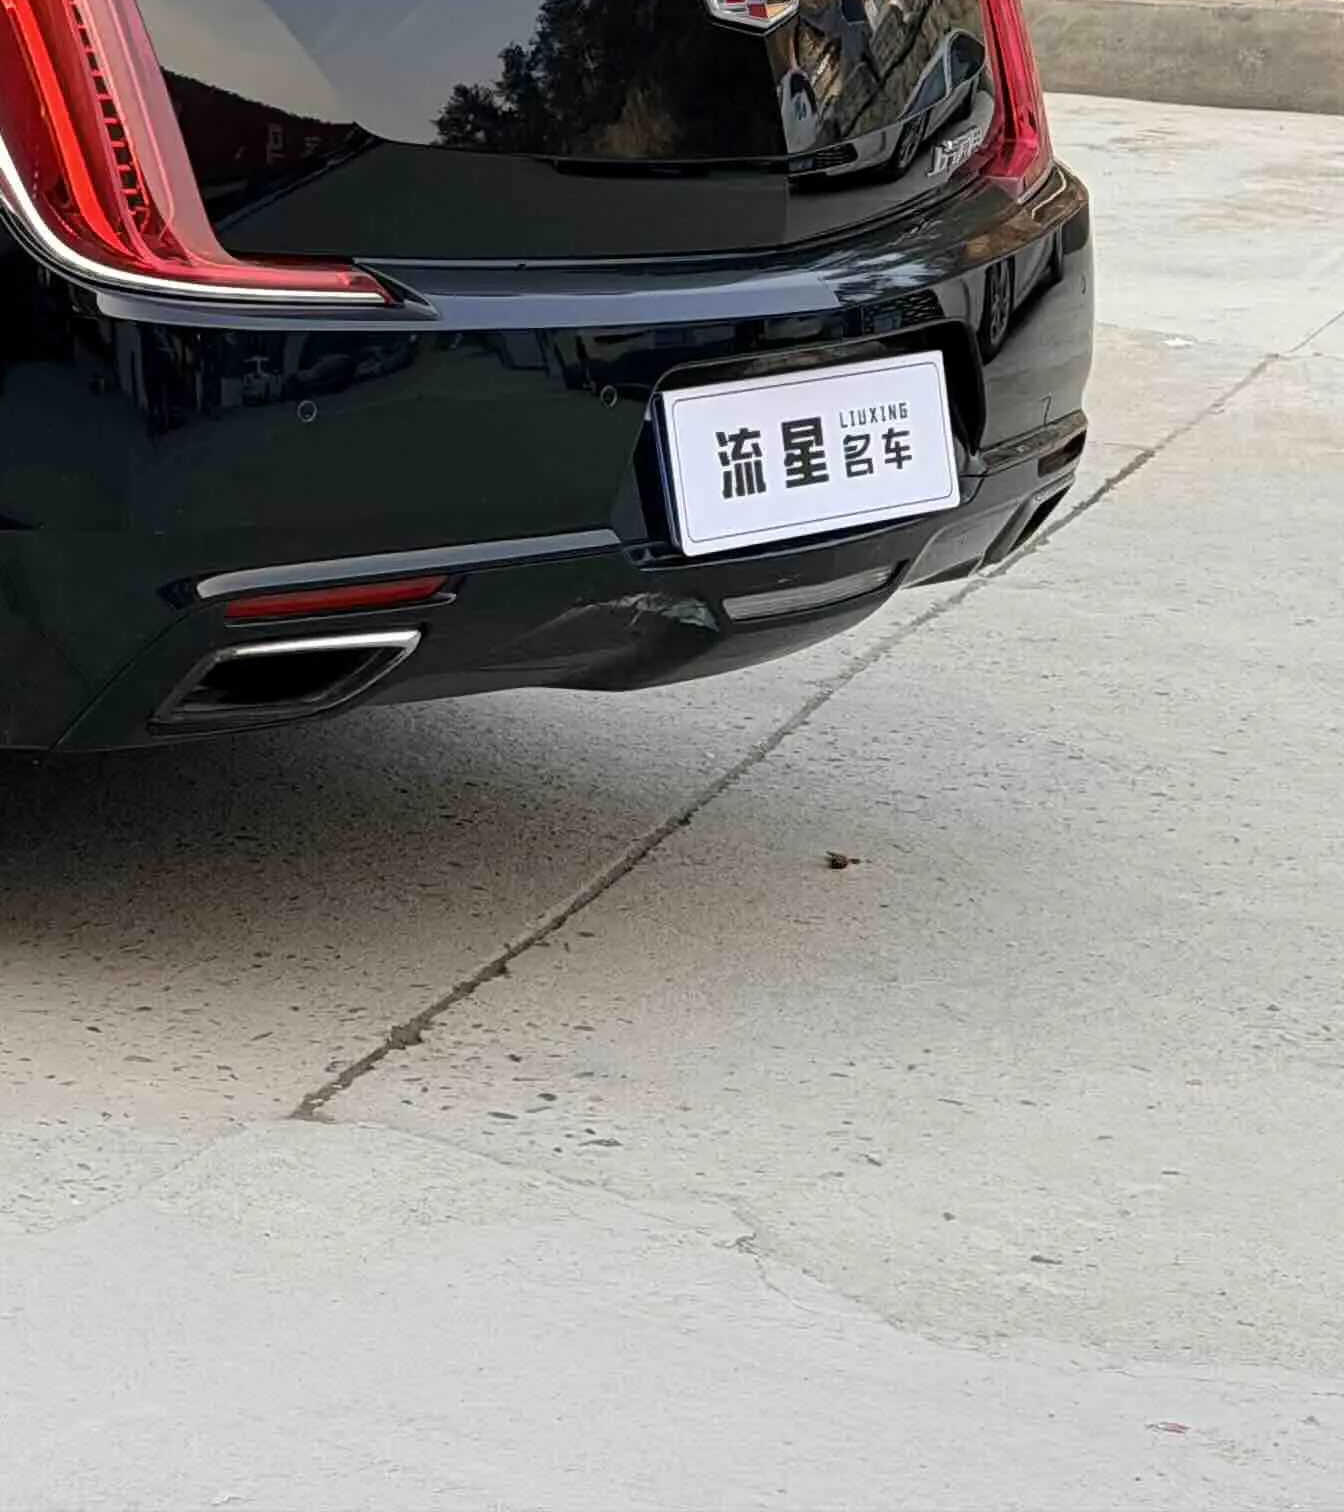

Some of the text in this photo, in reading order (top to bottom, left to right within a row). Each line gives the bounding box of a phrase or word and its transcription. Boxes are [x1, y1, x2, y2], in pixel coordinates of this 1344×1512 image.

[839, 402, 909, 429] LIUXING
[715, 416, 913, 499] 流星名车
